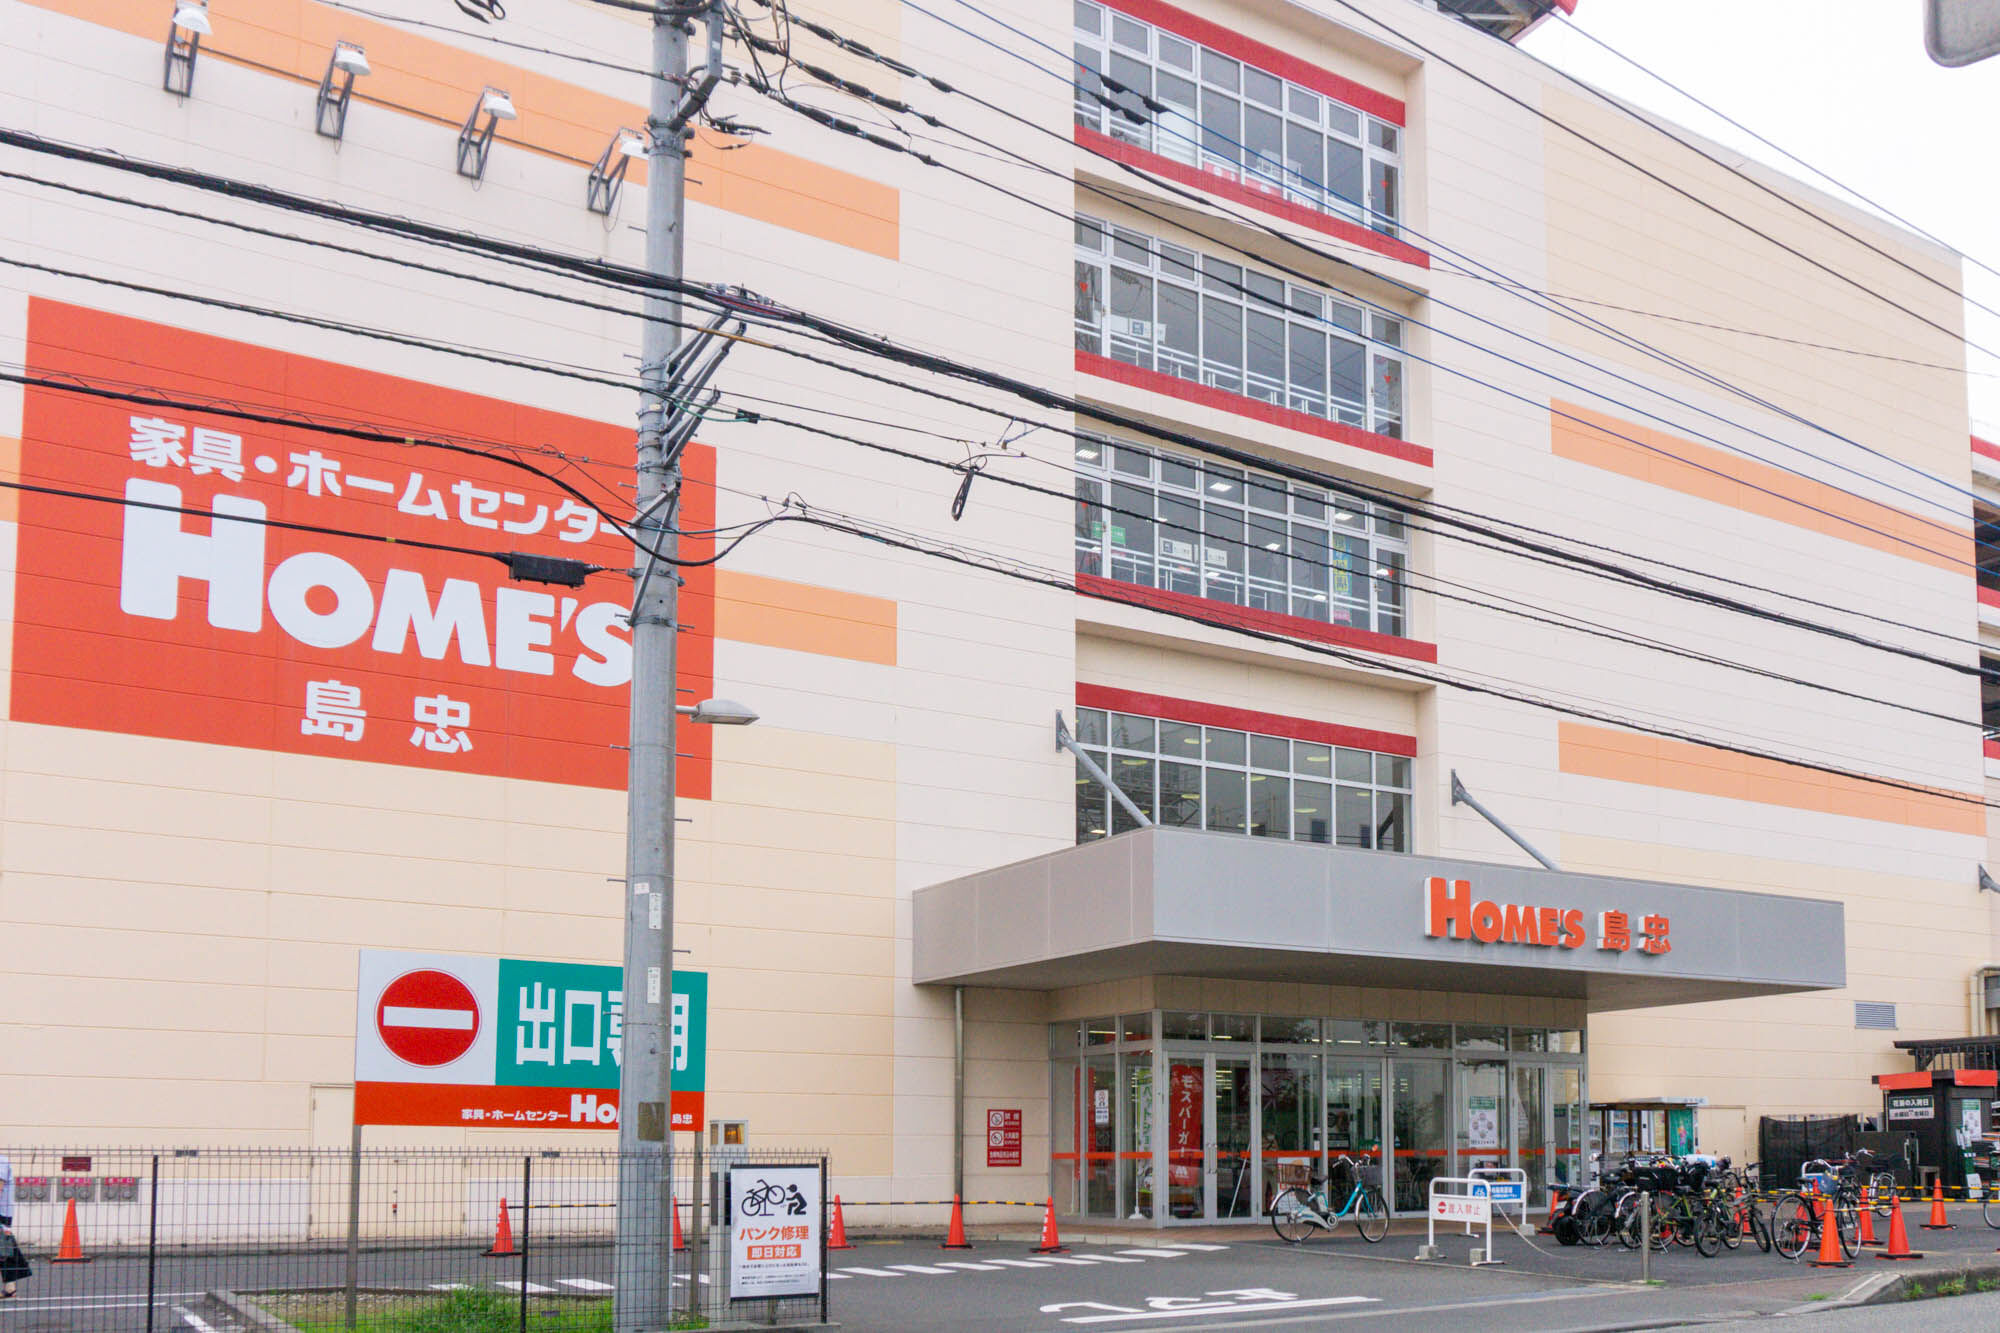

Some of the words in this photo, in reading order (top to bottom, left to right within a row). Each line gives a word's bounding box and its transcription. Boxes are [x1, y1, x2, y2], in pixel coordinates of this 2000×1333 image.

[130, 416, 636, 544] 家具・ホームセンター
[120, 477, 632, 686] HOME'S
[300, 679, 473, 754] 島忠
[1424, 876, 1586, 949] HOME'S
[1596, 908, 1672, 955] 島忠
[461, 1108, 568, 1121] 家具・ホームセンター
[1178, 1074, 1193, 1158] モスバーガー
[739, 1225, 809, 1240] パンク修理
[751, 1246, 798, 1258] 即日対応
